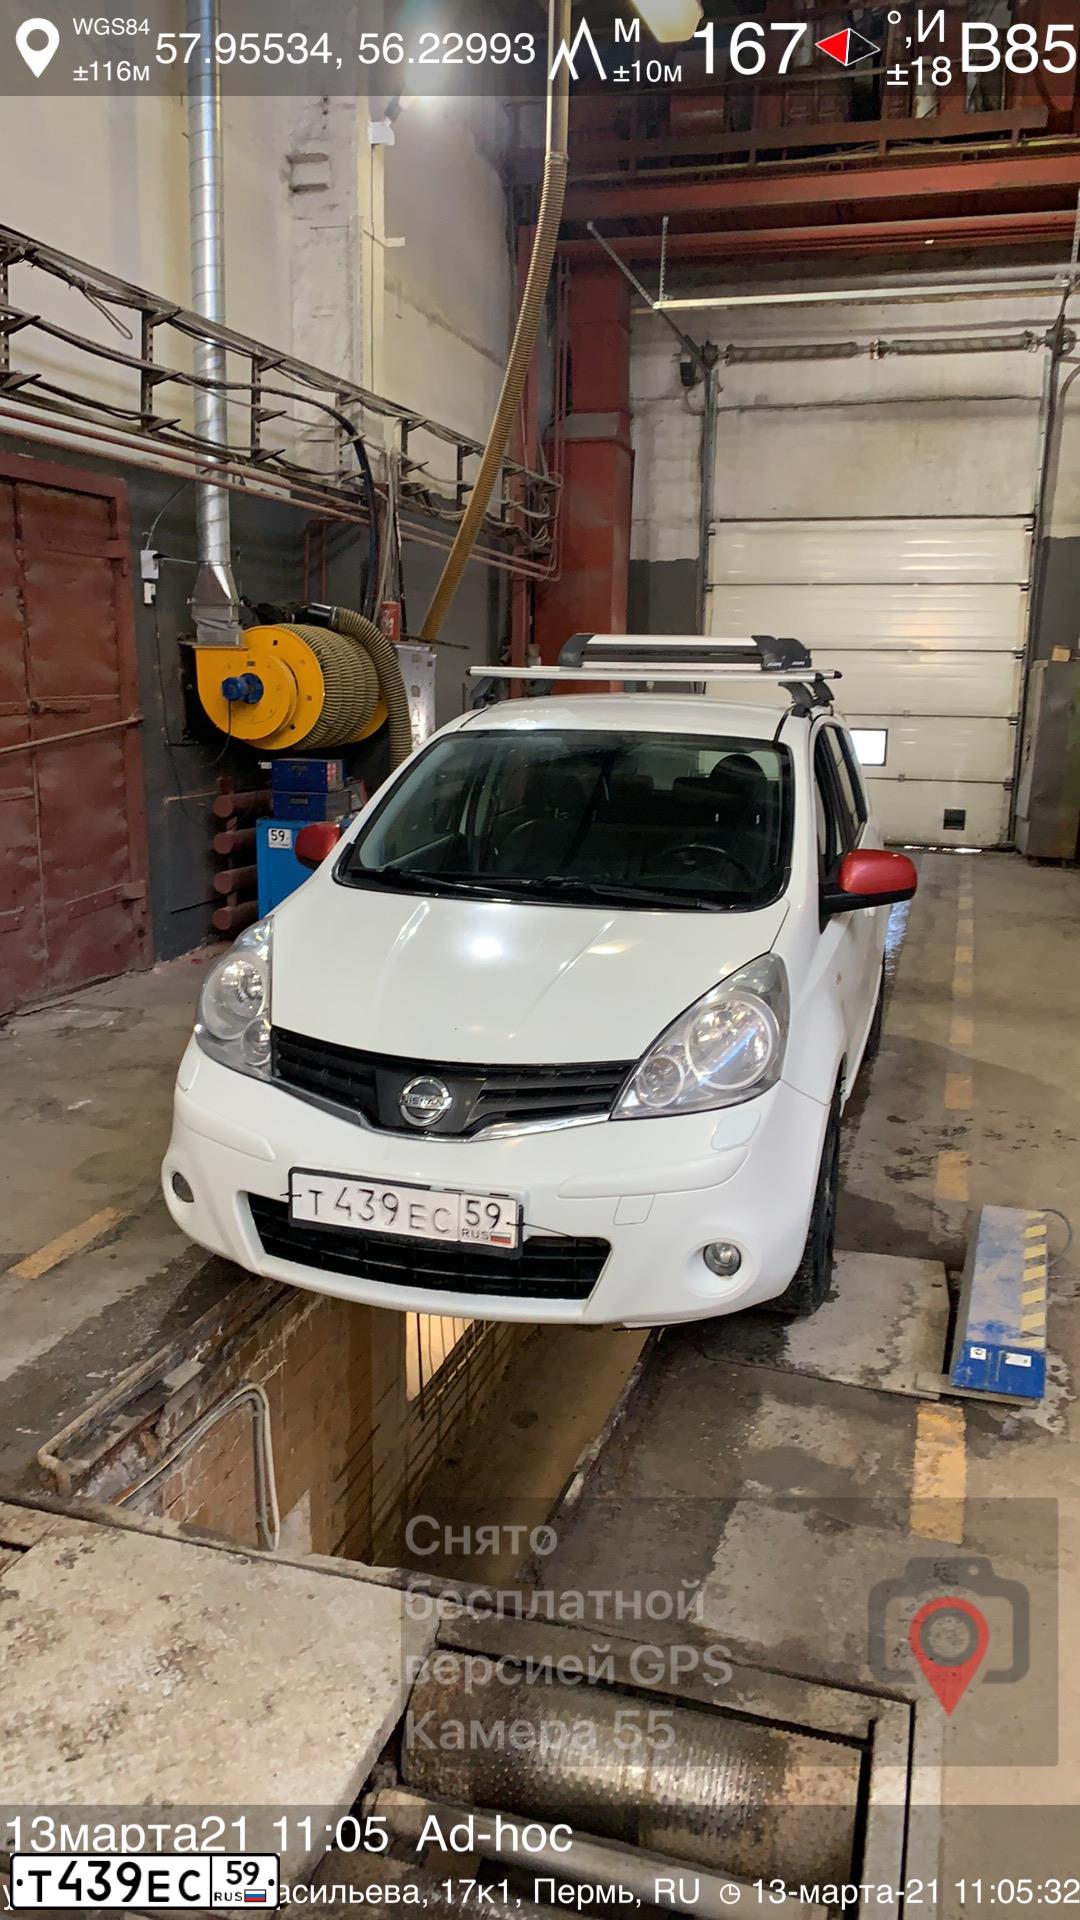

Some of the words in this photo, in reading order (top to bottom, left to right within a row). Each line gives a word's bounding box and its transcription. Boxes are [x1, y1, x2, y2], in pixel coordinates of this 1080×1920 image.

[271, 830, 285, 842] 59
[465, 1199, 502, 1229] 59
[461, 1228, 490, 1241] RUS
